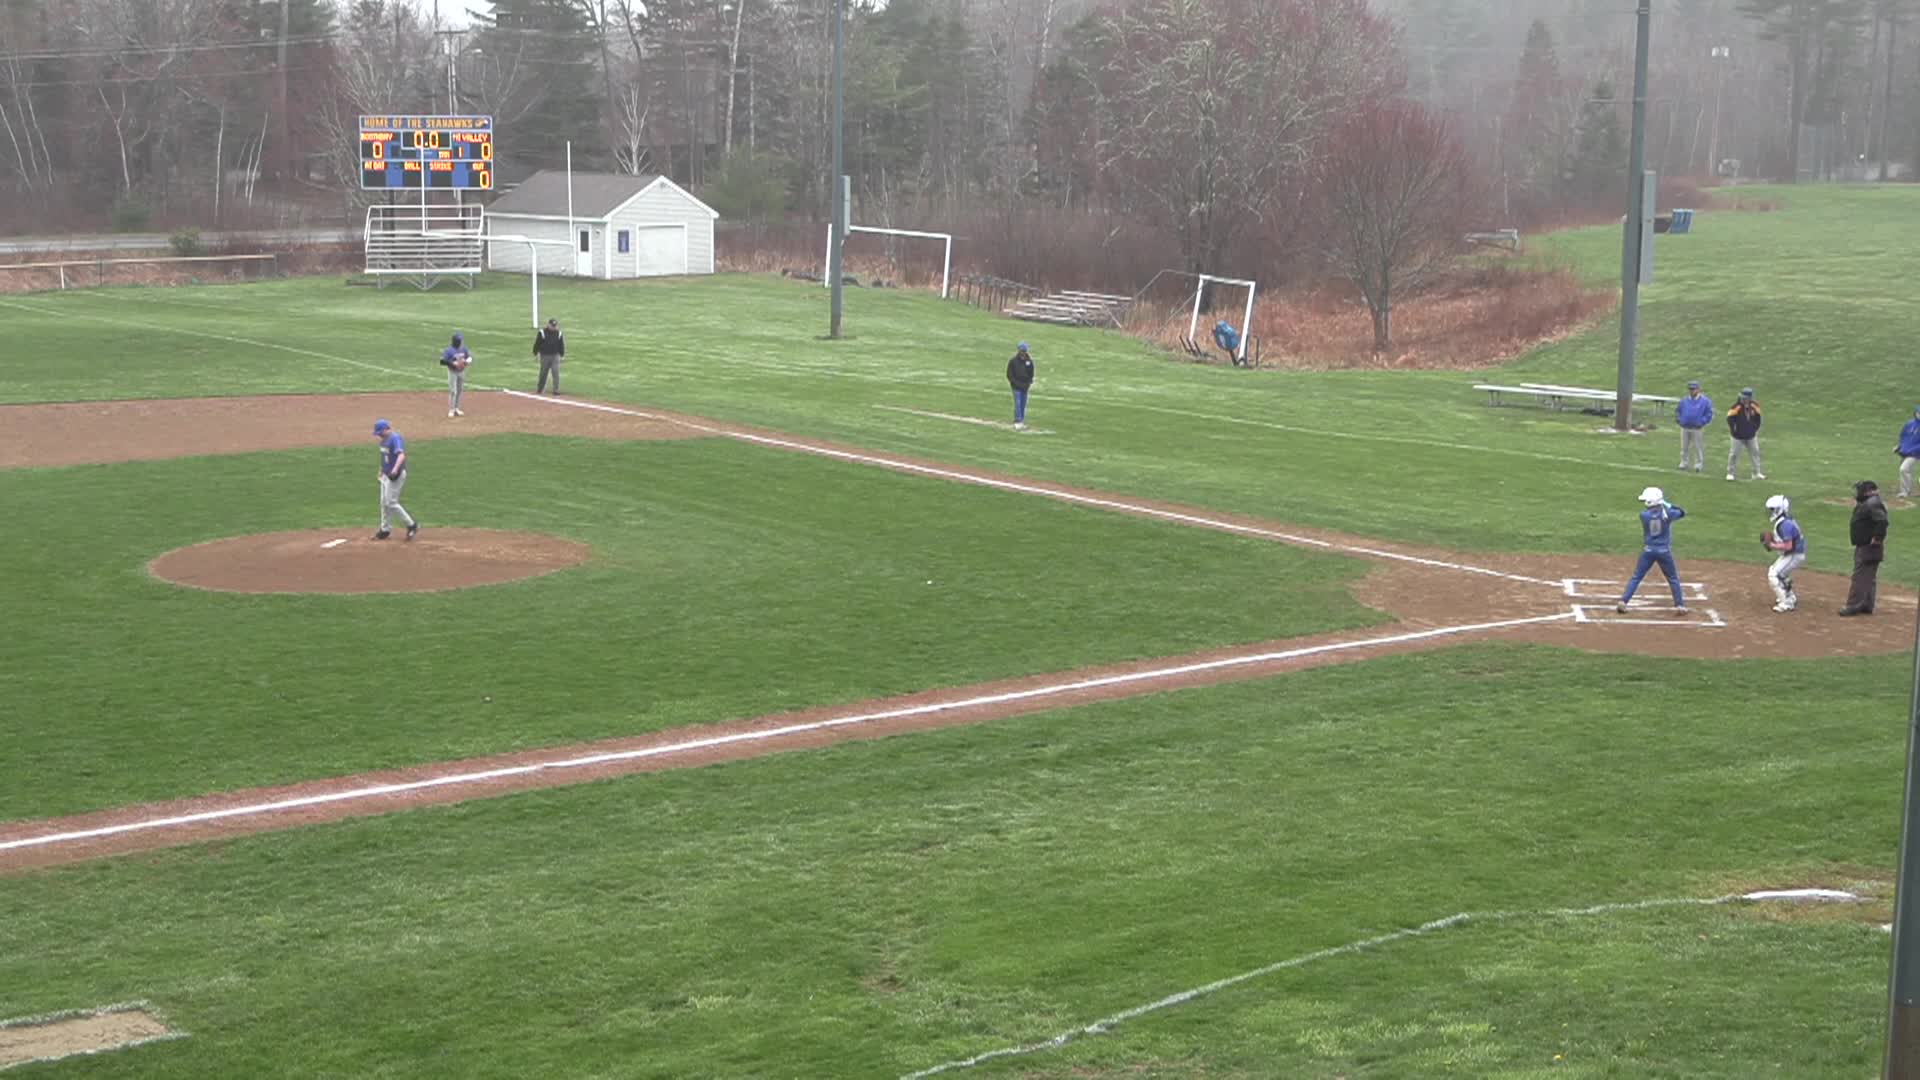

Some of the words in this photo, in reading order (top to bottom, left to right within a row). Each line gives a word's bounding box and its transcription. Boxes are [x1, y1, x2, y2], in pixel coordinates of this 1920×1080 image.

[364, 119, 389, 128] HOME
[393, 119, 402, 128] OF
[407, 119, 422, 128] THE
[426, 119, 473, 128] SEAHAWKS
[461, 133, 489, 143] VALLEY
[372, 141, 383, 159] 0
[481, 142, 492, 160] 0
[480, 170, 490, 189] 0
